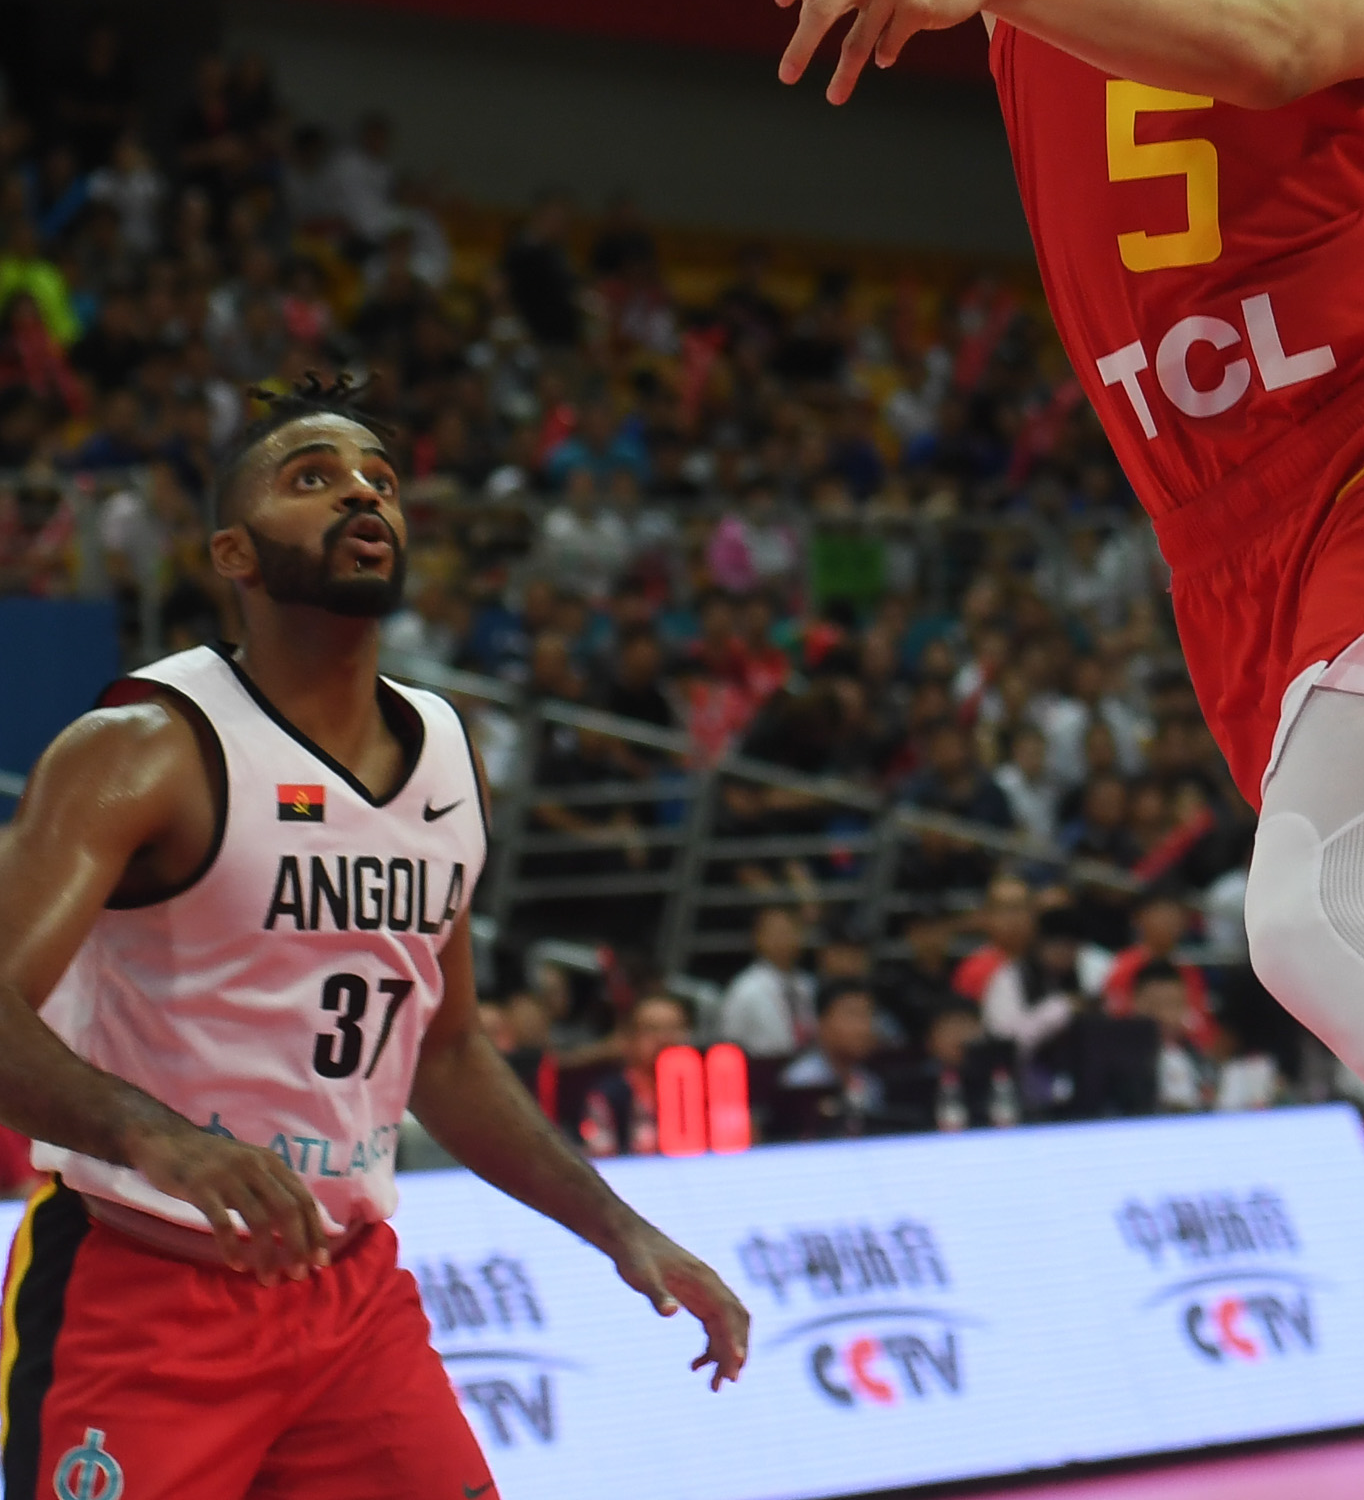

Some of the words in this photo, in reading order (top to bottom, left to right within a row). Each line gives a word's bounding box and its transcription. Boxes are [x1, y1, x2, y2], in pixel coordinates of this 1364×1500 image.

[1105, 79, 1223, 273] 5
[1095, 292, 1338, 440] TCL
[263, 854, 466, 935] ANGOLA
[312, 972, 417, 1081] 37
[809, 1332, 960, 1407] CCTV
[1183, 1295, 1316, 1362] CCTV
